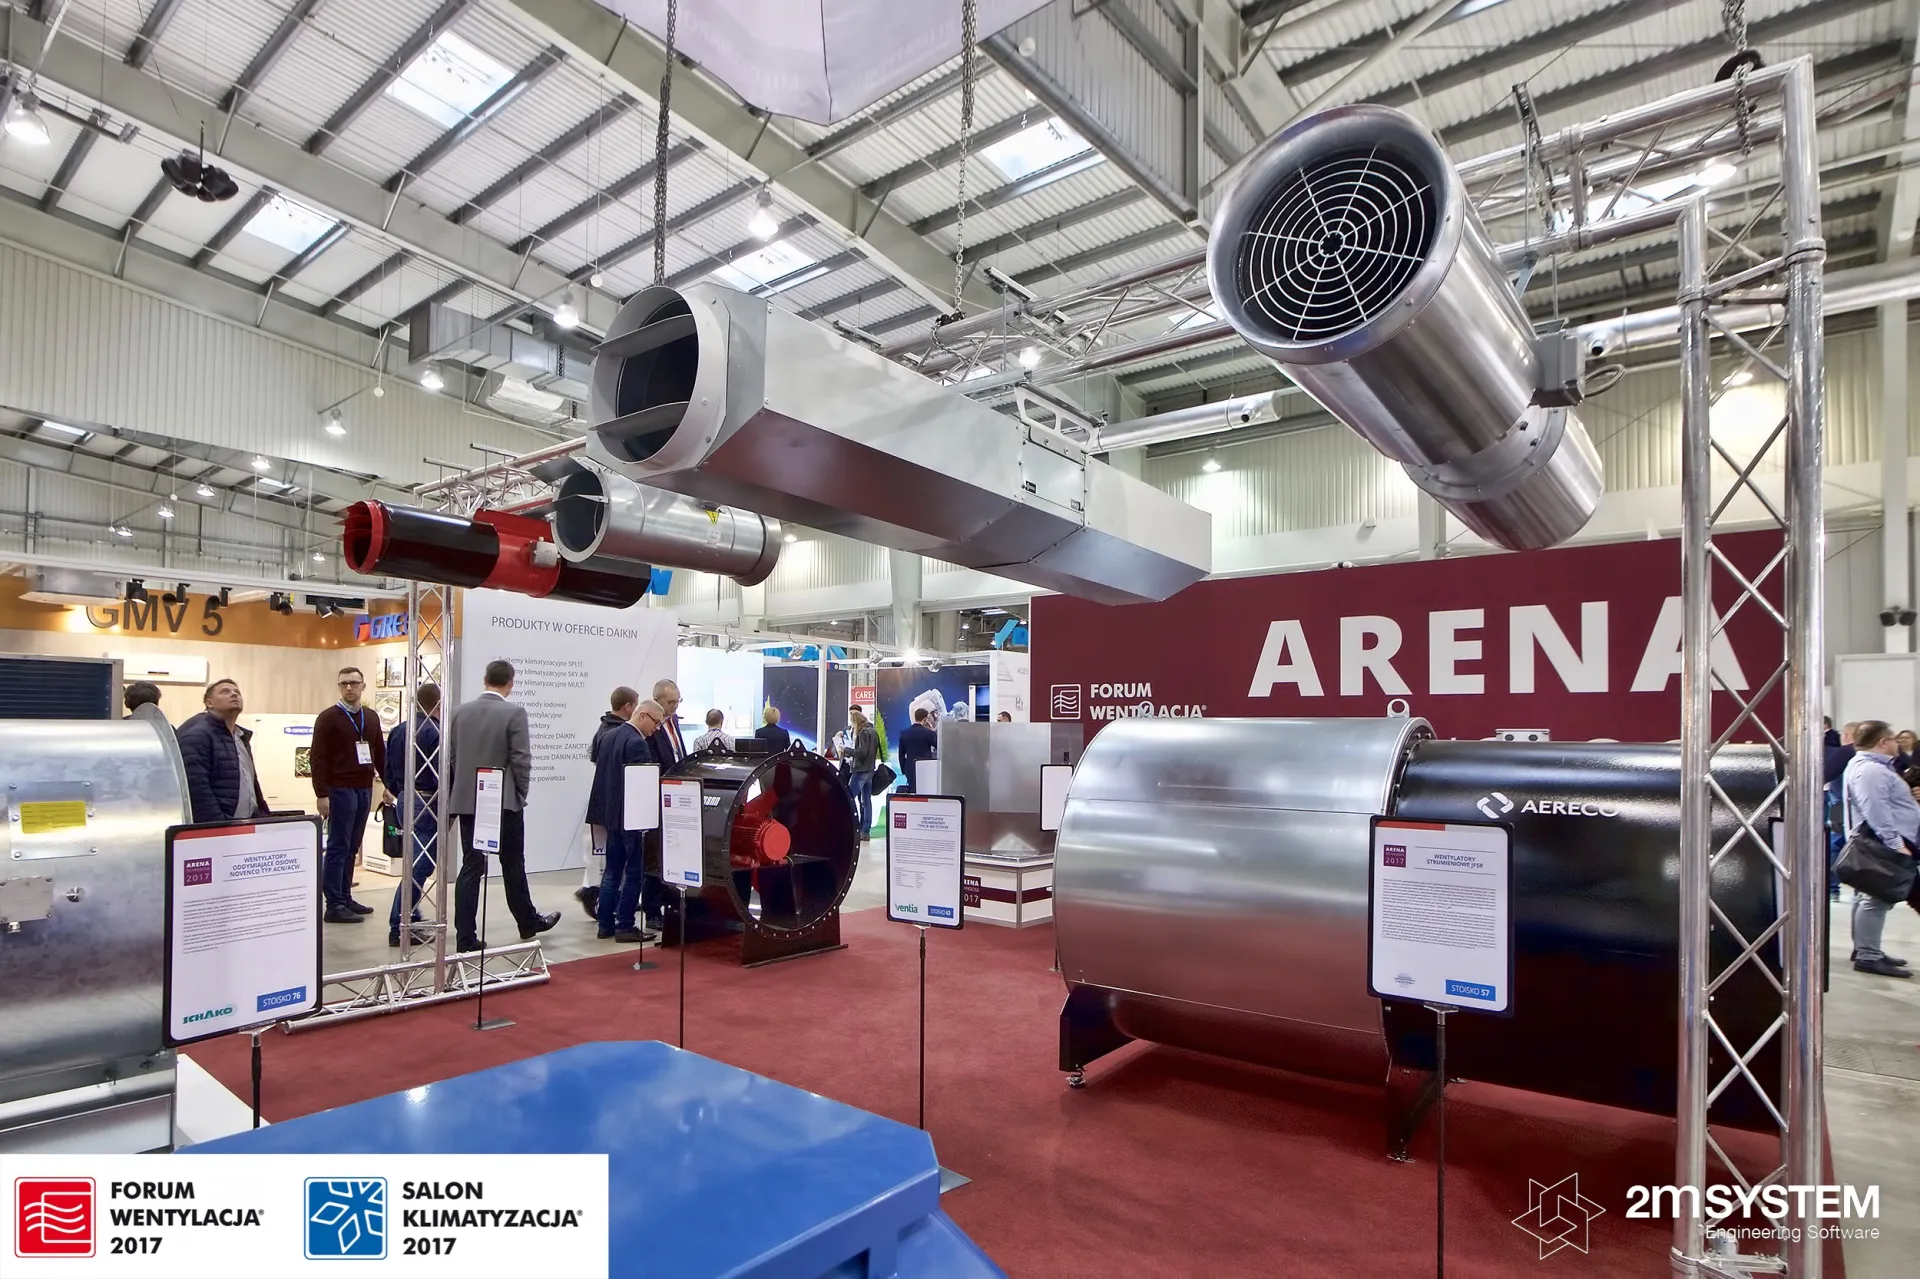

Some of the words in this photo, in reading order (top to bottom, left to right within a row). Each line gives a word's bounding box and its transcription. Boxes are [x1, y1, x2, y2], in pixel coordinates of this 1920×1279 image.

[86, 595, 189, 634] GMV
[202, 596, 223, 636] 5
[491, 616, 550, 631] PRODUKTY
[552, 623, 563, 632] W
[564, 623, 605, 636] OFERCIE
[606, 627, 638, 639] DAIKIN
[1248, 596, 1750, 698] ARENA
[524, 658, 567, 667] klimatyzacyjne
[524, 669, 567, 678] klimatyzacyjne
[524, 679, 567, 688] klimatyzacyjne
[1090, 682, 1152, 698] FORUM
[526, 701, 543, 709] wody
[1520, 800, 1619, 817] AERECO
[244, 854, 287, 863] WENTYLATORY
[275, 858, 298, 866] OSIOWE
[1434, 854, 1476, 862] WENTYLATORY
[186, 860, 210, 868] ARENA
[1426, 859, 1470, 868] STRUMIENIOWE
[186, 873, 210, 882] 2017
[230, 869, 260, 878] NOVENCO
[964, 894, 979, 903] 017
[1451, 984, 1480, 995] STOISKO
[1481, 989, 1490, 997] 57
[262, 994, 292, 1008] STOISKO
[292, 992, 301, 1000] 76
[183, 1007, 233, 1024] SCHAKO
